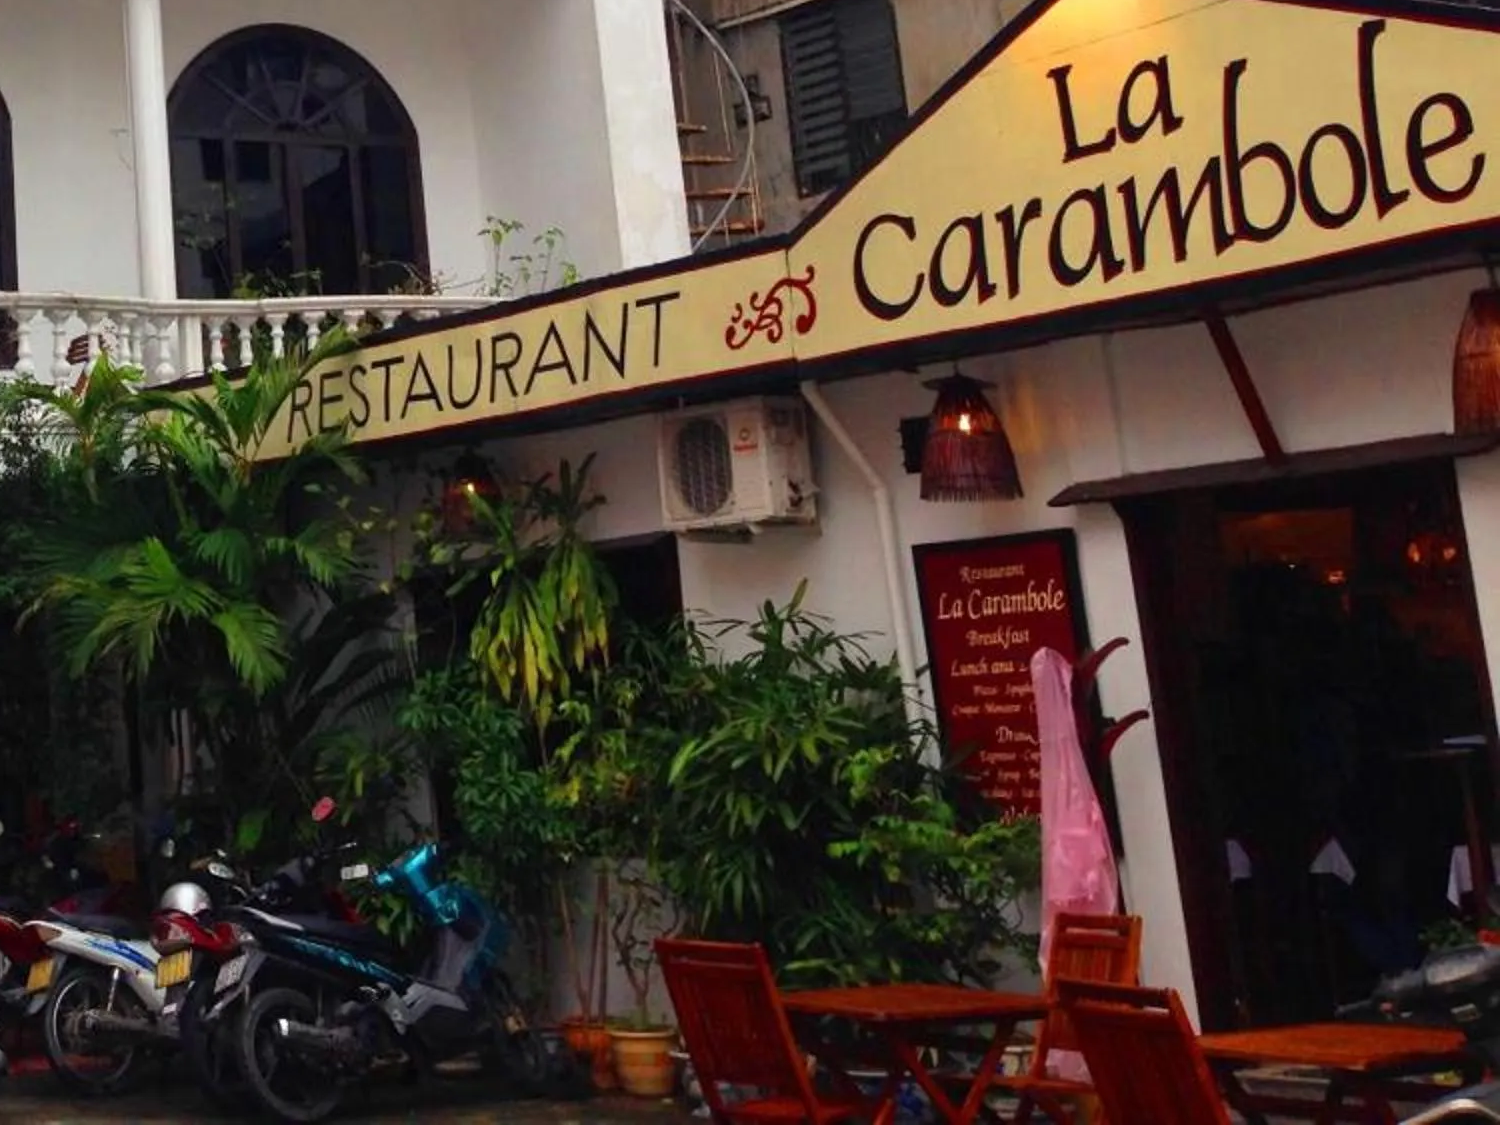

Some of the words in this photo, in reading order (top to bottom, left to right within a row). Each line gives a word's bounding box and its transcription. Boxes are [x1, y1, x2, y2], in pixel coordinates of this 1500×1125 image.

[1047, 54, 1185, 163] La
[852, 18, 1487, 321] Carambole
[286, 290, 681, 444] RESTAURANT
[937, 591, 965, 620] La
[967, 578, 1066, 620] Carambole
[951, 656, 988, 677] Lunch
[965, 625, 1030, 650] Breakfast
